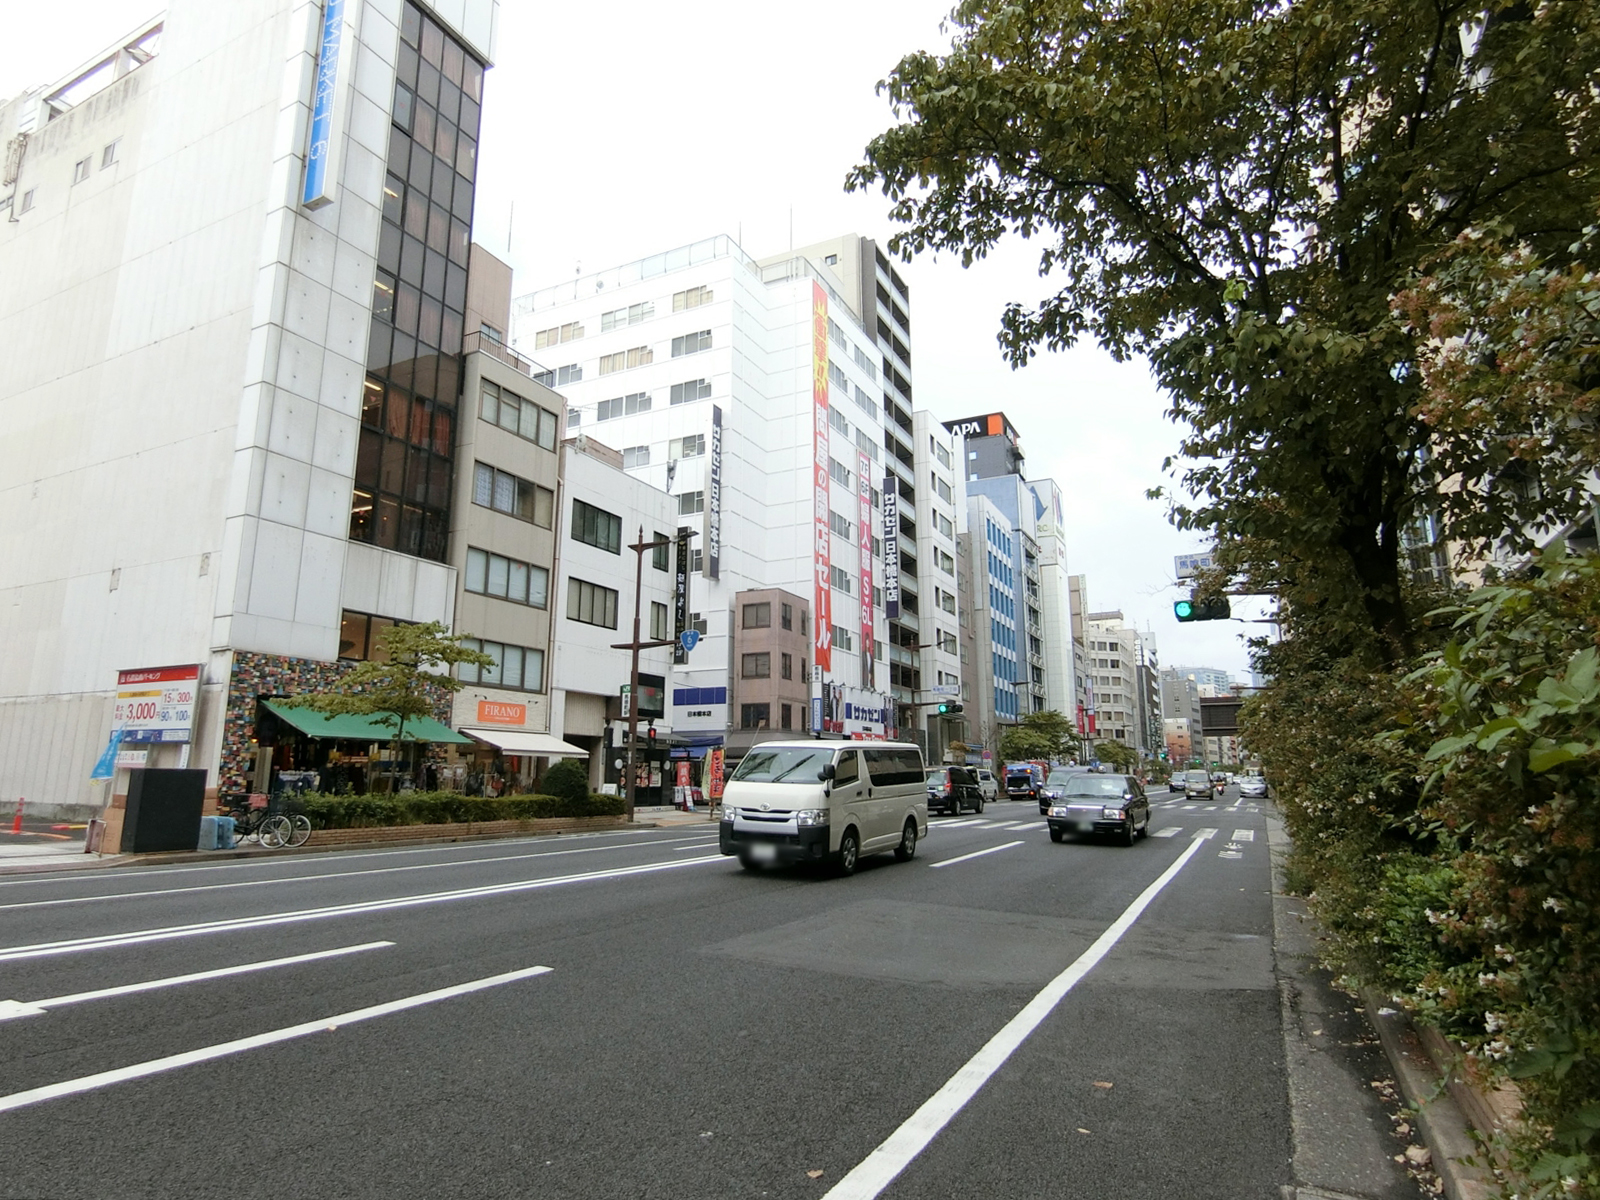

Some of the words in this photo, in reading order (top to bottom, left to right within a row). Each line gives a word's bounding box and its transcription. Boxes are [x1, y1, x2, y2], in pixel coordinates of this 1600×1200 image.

[314, 15, 342, 121] MARKET
[951, 421, 981, 437] APA
[860, 460, 869, 476] 7F
[860, 480, 869, 496] 6F
[862, 606, 872, 627] 6L
[687, 635, 693, 644] 6
[484, 704, 520, 718] FIRANO
[853, 705, 881, 724] サカゼン
